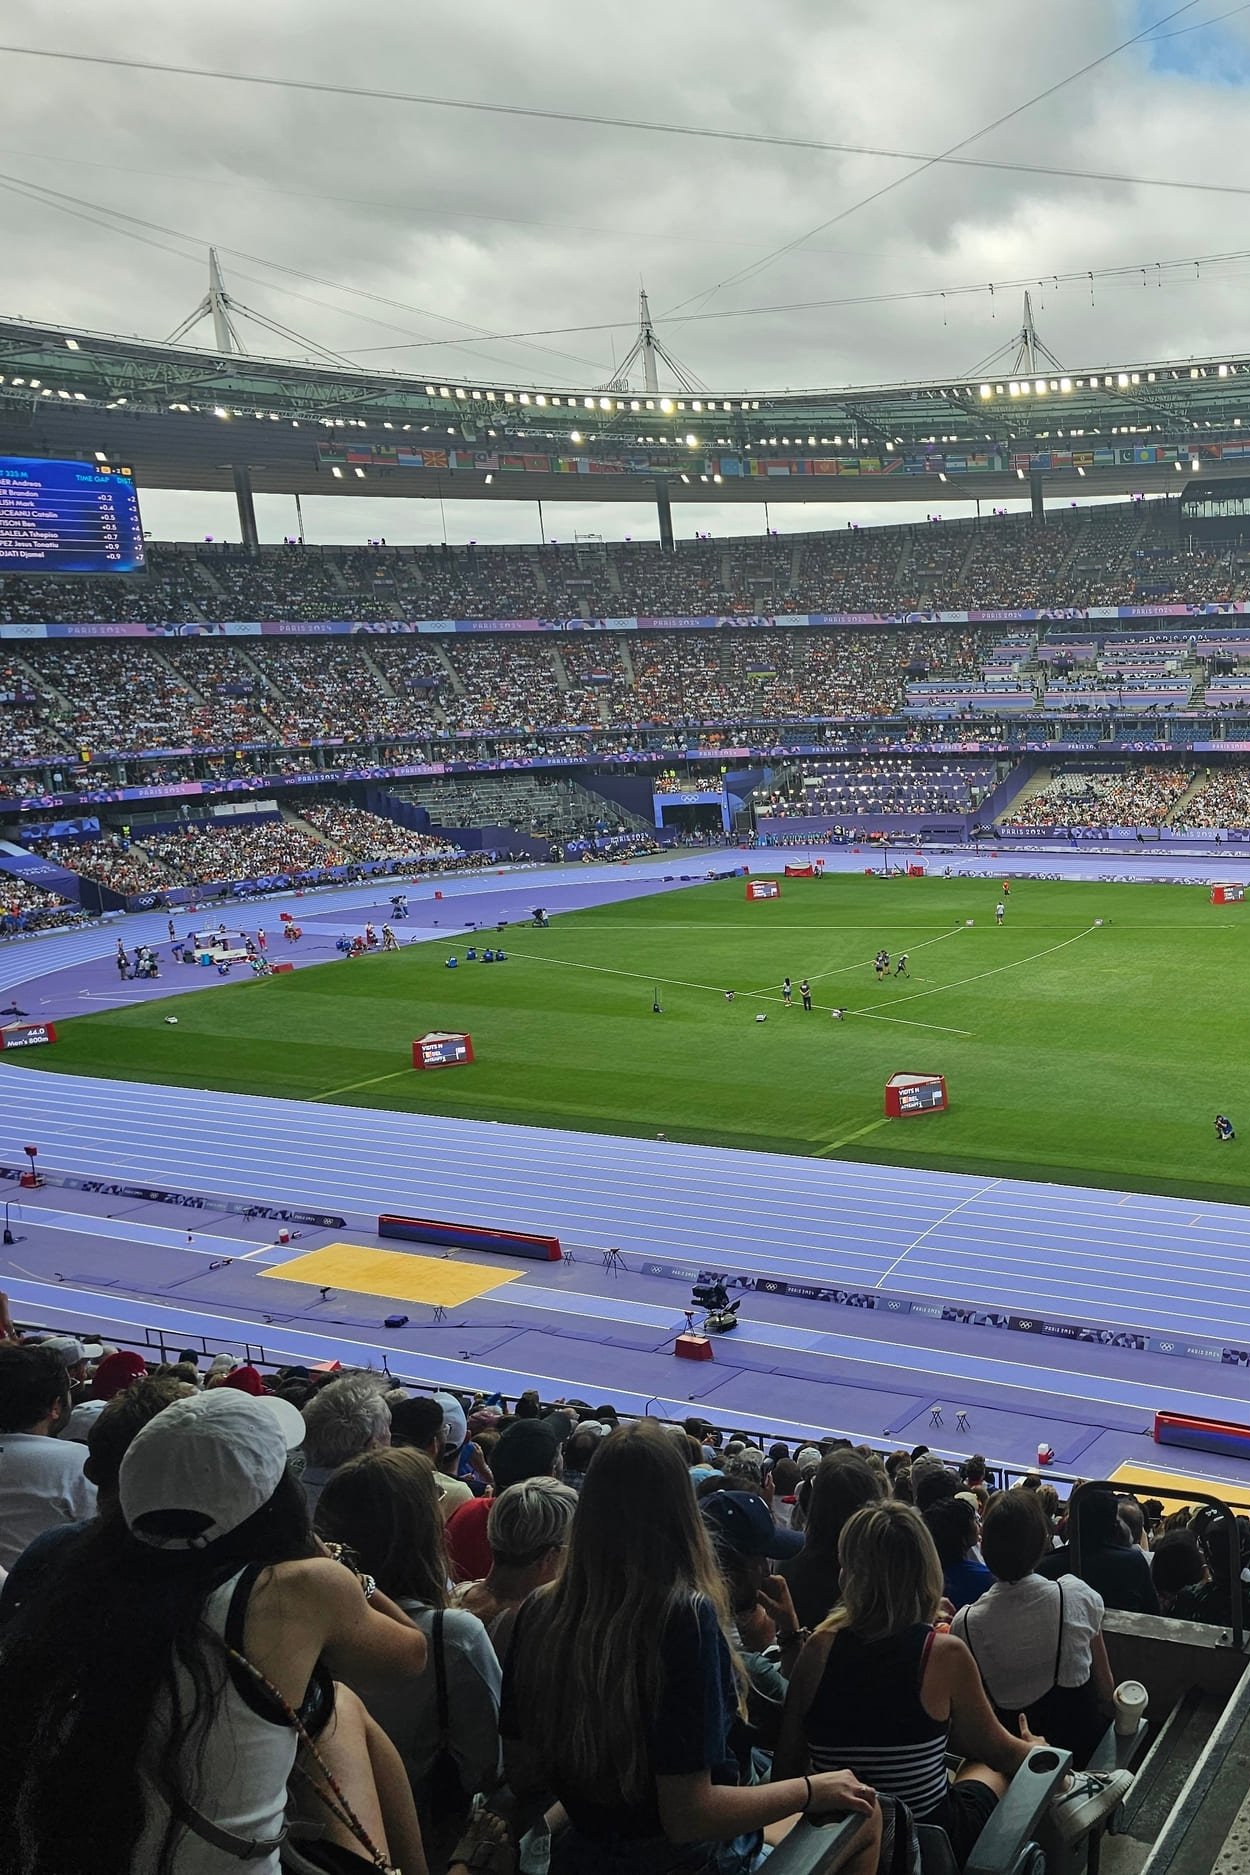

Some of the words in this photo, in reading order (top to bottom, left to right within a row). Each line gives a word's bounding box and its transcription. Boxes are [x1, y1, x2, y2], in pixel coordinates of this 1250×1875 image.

[9, 489, 39, 497] Brandon
[29, 530, 59, 539] Tshepiso
[20, 550, 45, 558] Djamel
